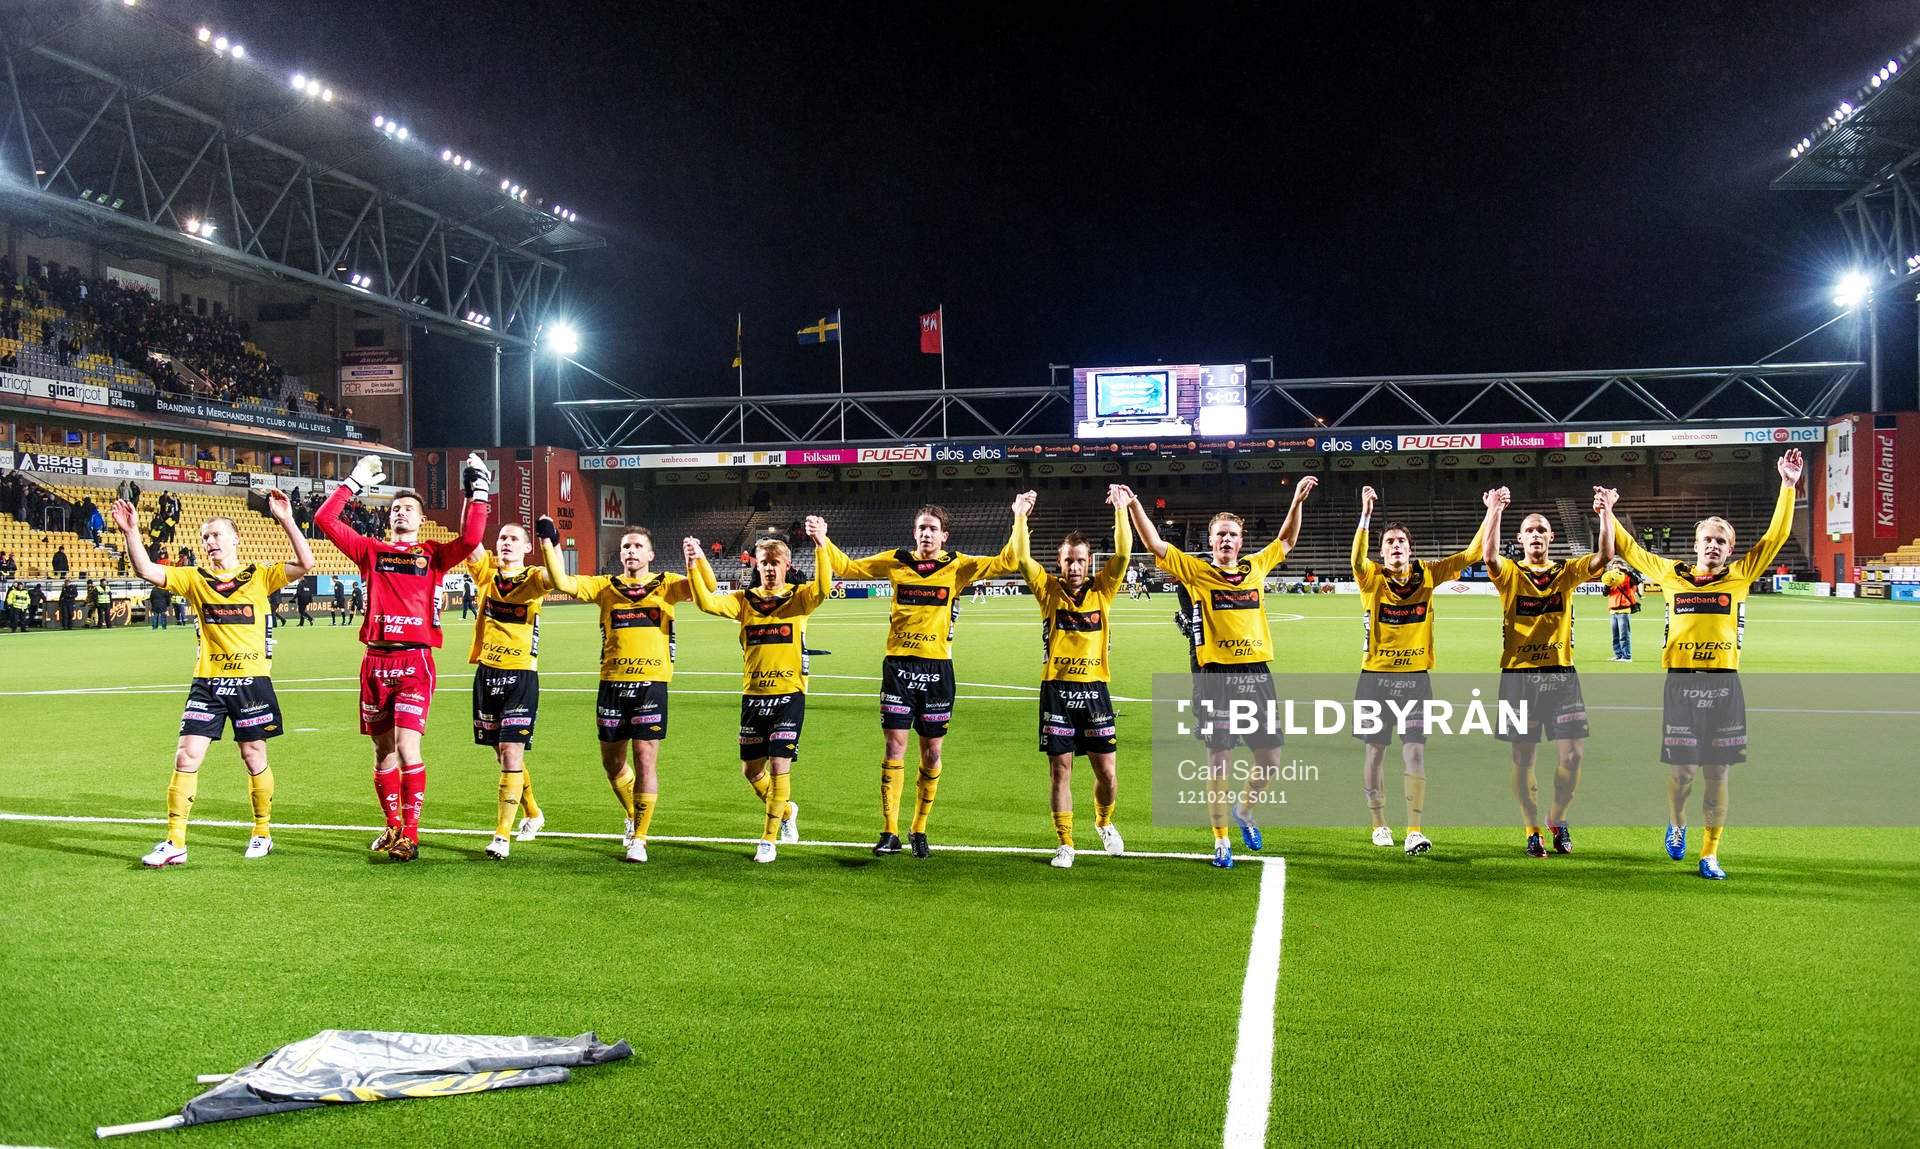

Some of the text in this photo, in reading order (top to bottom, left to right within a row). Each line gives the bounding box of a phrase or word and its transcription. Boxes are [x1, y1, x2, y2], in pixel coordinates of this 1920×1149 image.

[0, 374, 32, 392] tricot
[157, 400, 331, 433] BRANDING & MERCHANDISE TO CLUBS ON ALL LEVELS
[1322, 438, 1352, 451] ellos
[1362, 436, 1392, 450] ellos
[1402, 436, 1476, 448] PULSEN
[1501, 436, 1544, 446] Folksam
[804, 452, 840, 462] Folksam
[862, 449, 926, 460] PULSEN
[936, 447, 964, 460] ellos
[972, 446, 1000, 460] ellos
[37, 454, 84, 468] 8848
[38, 464, 84, 475] ALTITUDE
[1878, 435, 1894, 526] Knalleland
[519, 467, 530, 533] nalleland
[445, 582, 458, 590] NCC
[1676, 596, 1716, 604] Swedbank
[384, 625, 404, 634] BIL
[902, 641, 920, 649] BIL
[1678, 642, 1732, 650] TOVEKS
[1234, 648, 1252, 656] BIL
[1379, 648, 1424, 658] TOVEKS
[1532, 652, 1550, 660] BIL
[1692, 651, 1716, 660] BIL
[210, 653, 258, 662] TOVEKS
[487, 653, 502, 663] BIL
[613, 658, 662, 666] TOVEKS
[1054, 657, 1100, 666] TOVEKS
[626, 666, 646, 674] BIL
[1068, 667, 1088, 675] BIL
[216, 687, 238, 696] BIL
[1067, 700, 1086, 708] BIL
